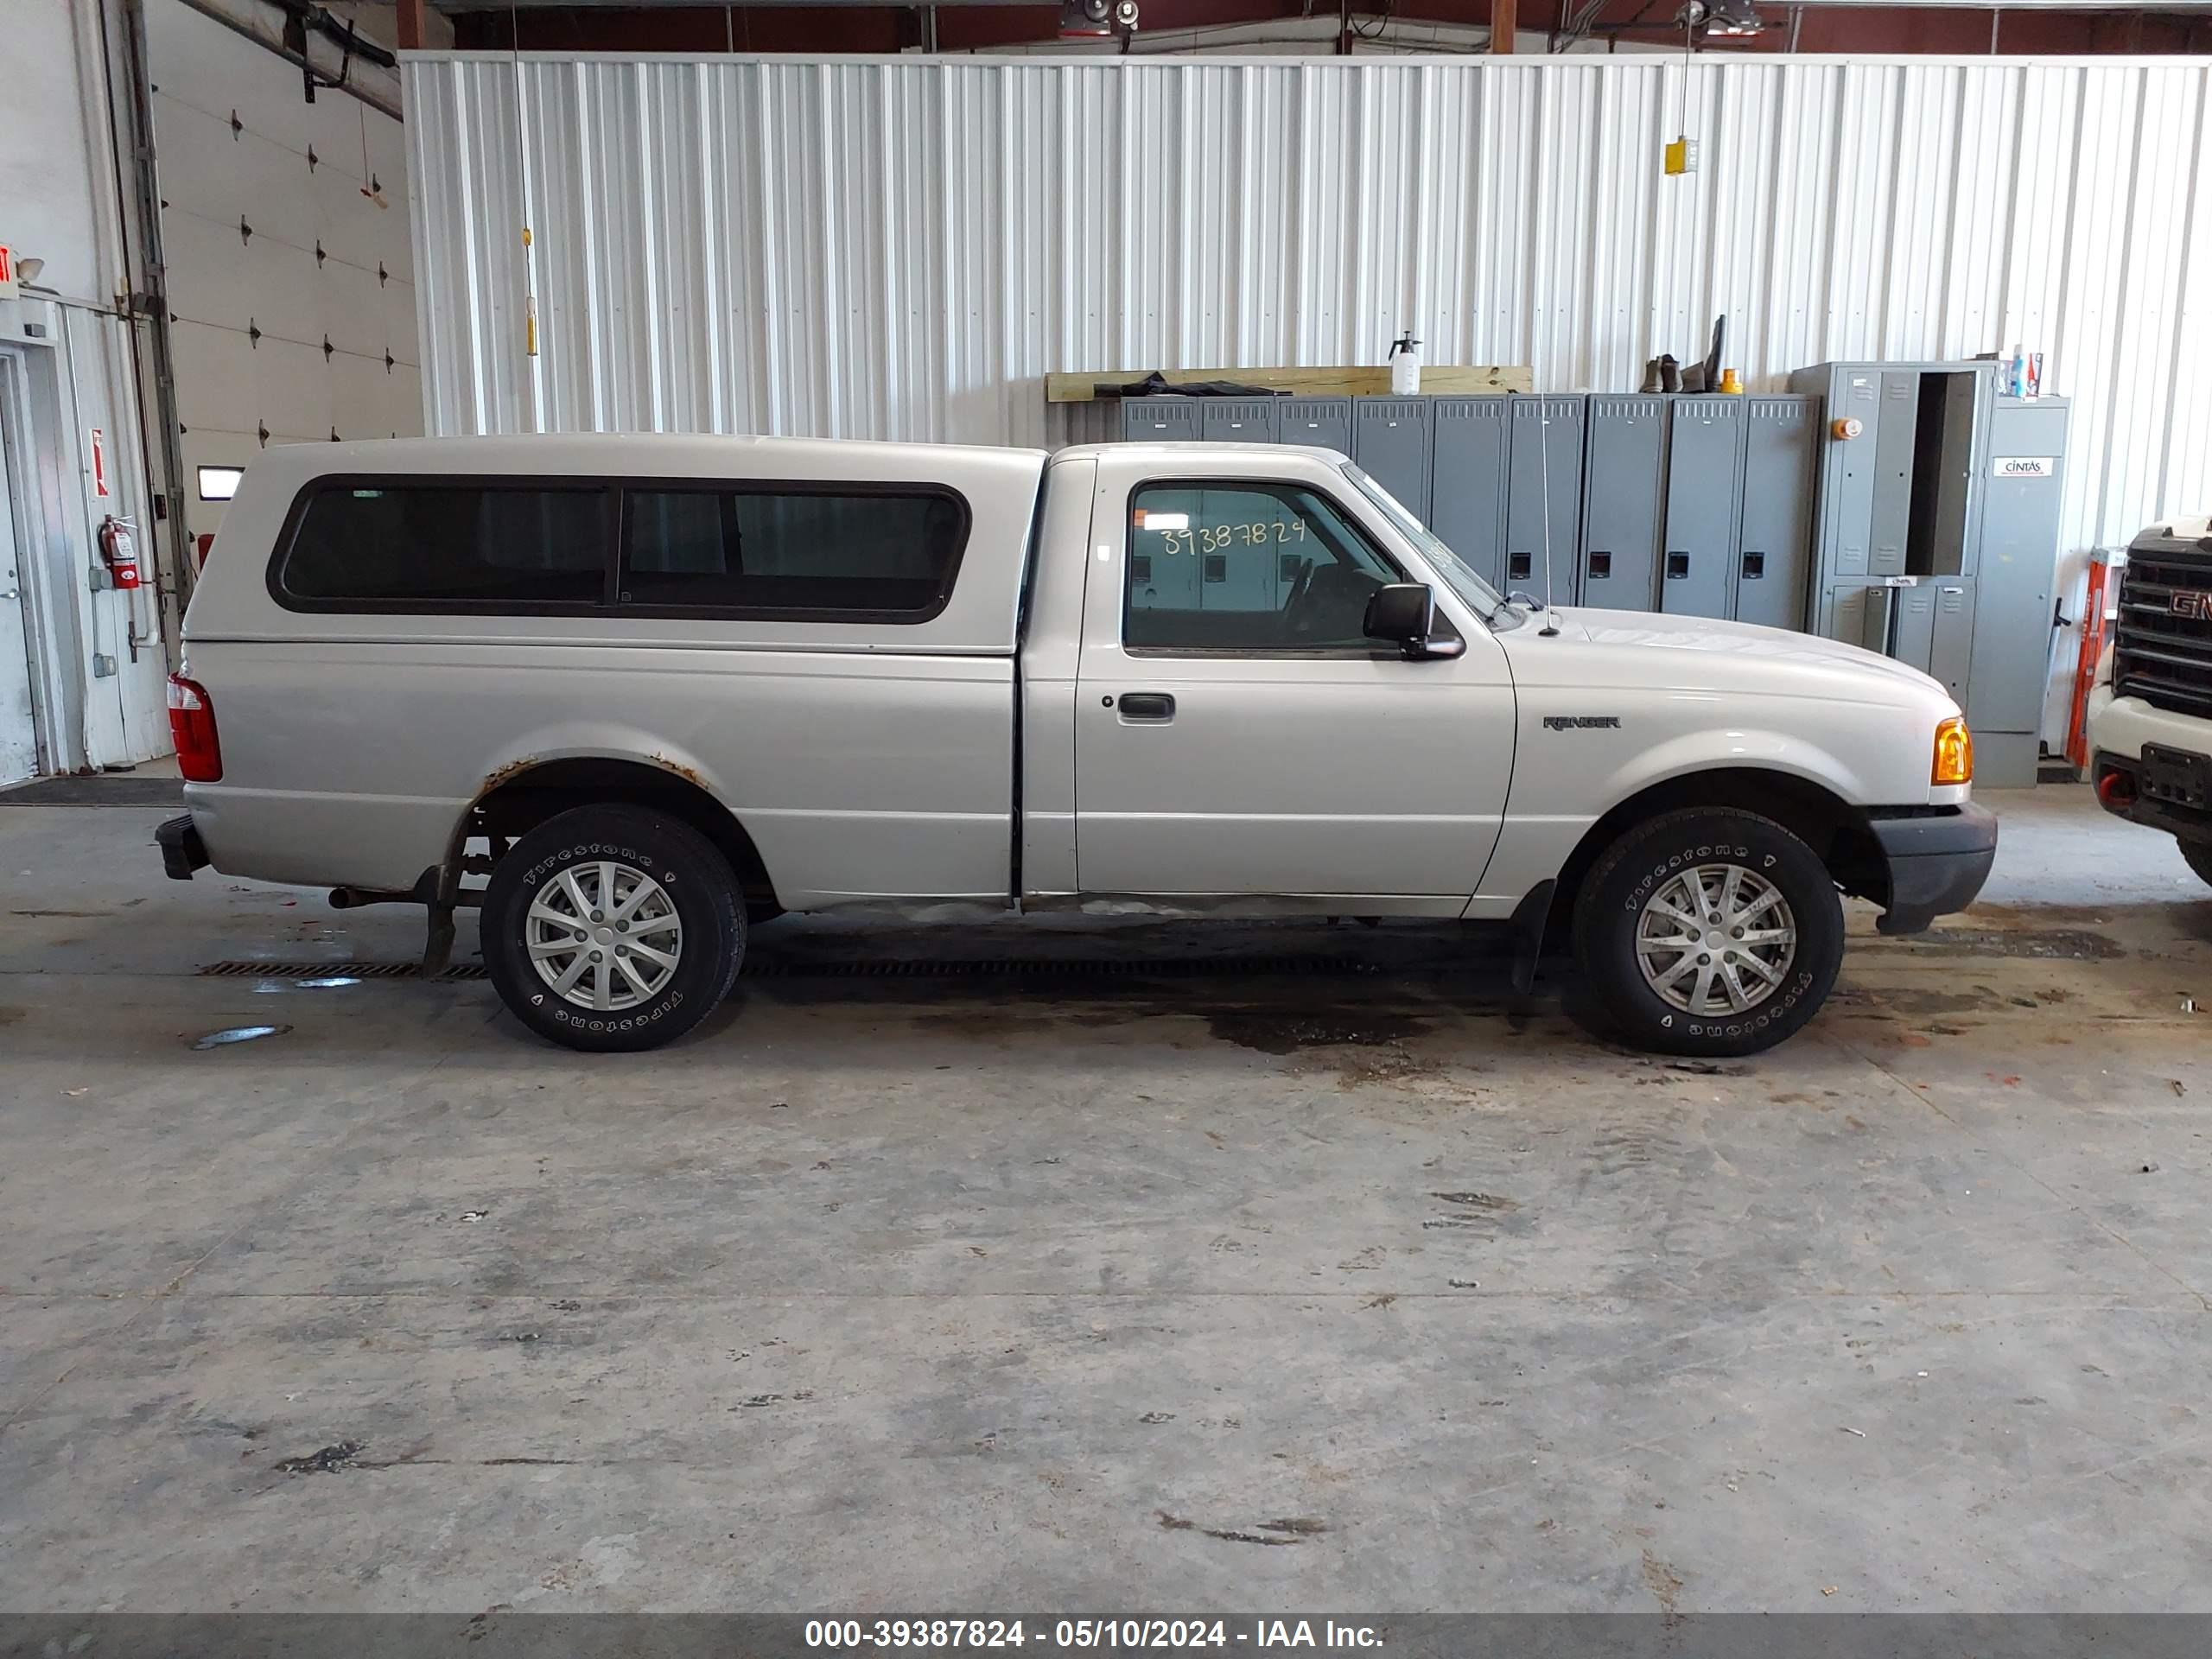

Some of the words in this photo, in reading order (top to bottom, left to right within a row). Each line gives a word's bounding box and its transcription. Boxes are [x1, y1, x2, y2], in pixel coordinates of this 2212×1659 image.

[1543, 716, 1622, 731] RANGER
[523, 843, 652, 886] Firestone
[1624, 845, 1749, 911] Firestone
[555, 990, 683, 1033] Firestone
[1688, 972, 1813, 1037] Firestone
